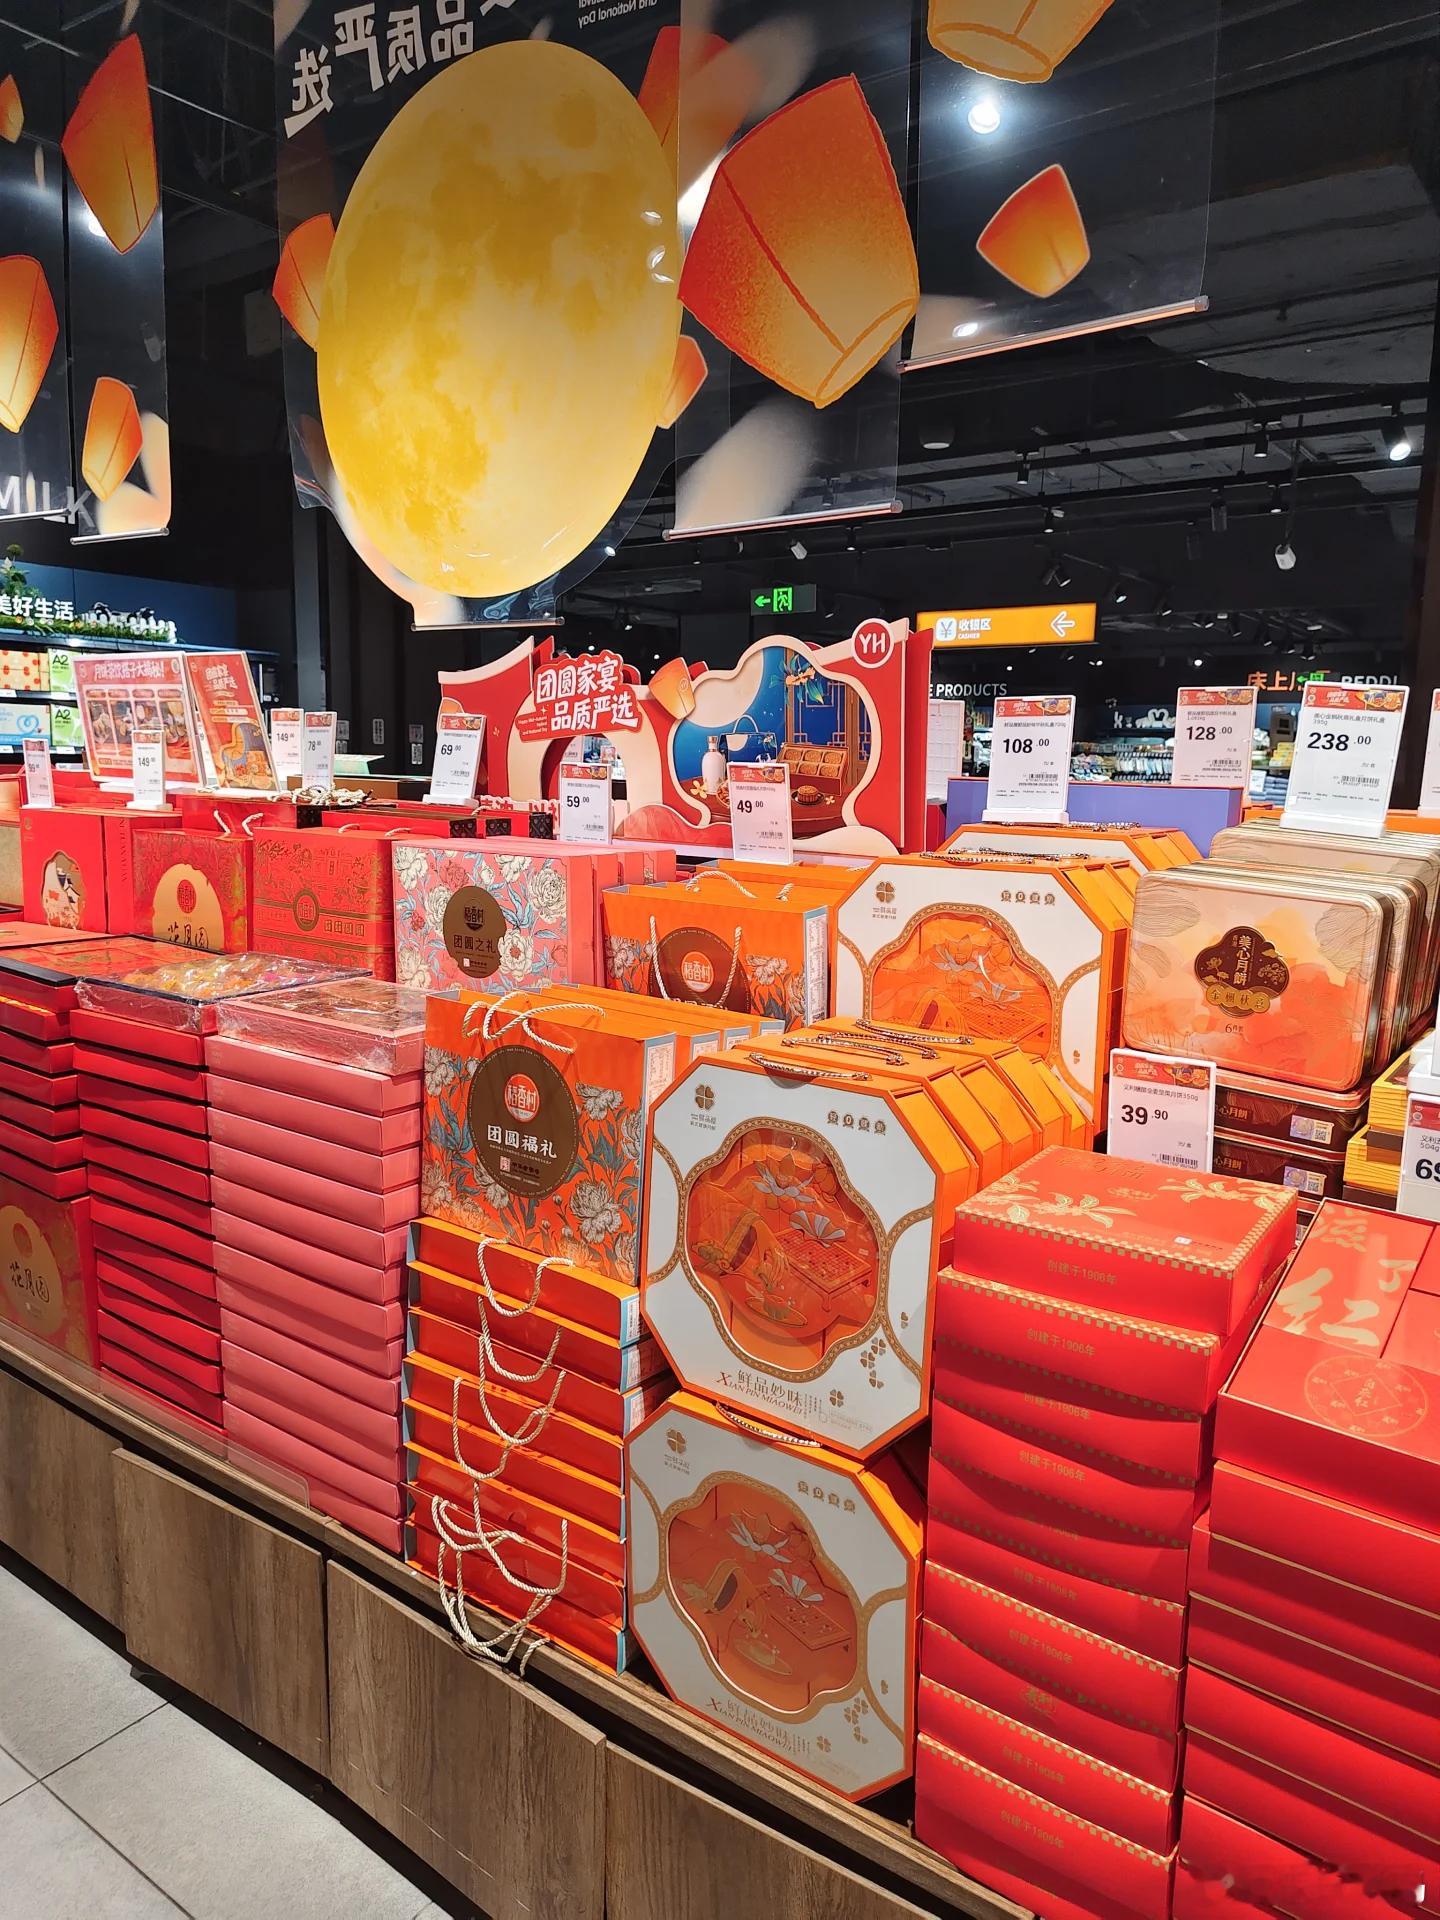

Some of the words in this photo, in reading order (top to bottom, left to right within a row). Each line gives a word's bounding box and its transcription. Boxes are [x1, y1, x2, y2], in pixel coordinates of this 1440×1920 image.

[0, 594, 75, 622] 美好生活
[958, 617, 992, 631] 收银区
[858, 632, 887, 654] YH
[52, 654, 69, 667] A2
[536, 655, 619, 704] 团圆家宴
[935, 682, 1008, 697] PRODUCTS
[54, 708, 71, 721] A2
[550, 690, 639, 732] 品质严选
[276, 732, 289, 743] 149
[308, 740, 316, 752] 78
[441, 743, 453, 756] 69
[138, 756, 150, 768] 149
[566, 795, 580, 808] 59
[737, 799, 753, 814] 49
[683, 961, 711, 984] 稻香村
[507, 1084, 537, 1112] 稻香村
[487, 1124, 558, 1160] 团圆福礼
[737, 1369, 803, 1407] 鲜品妙味
[745, 1387, 760, 1399] PIN
